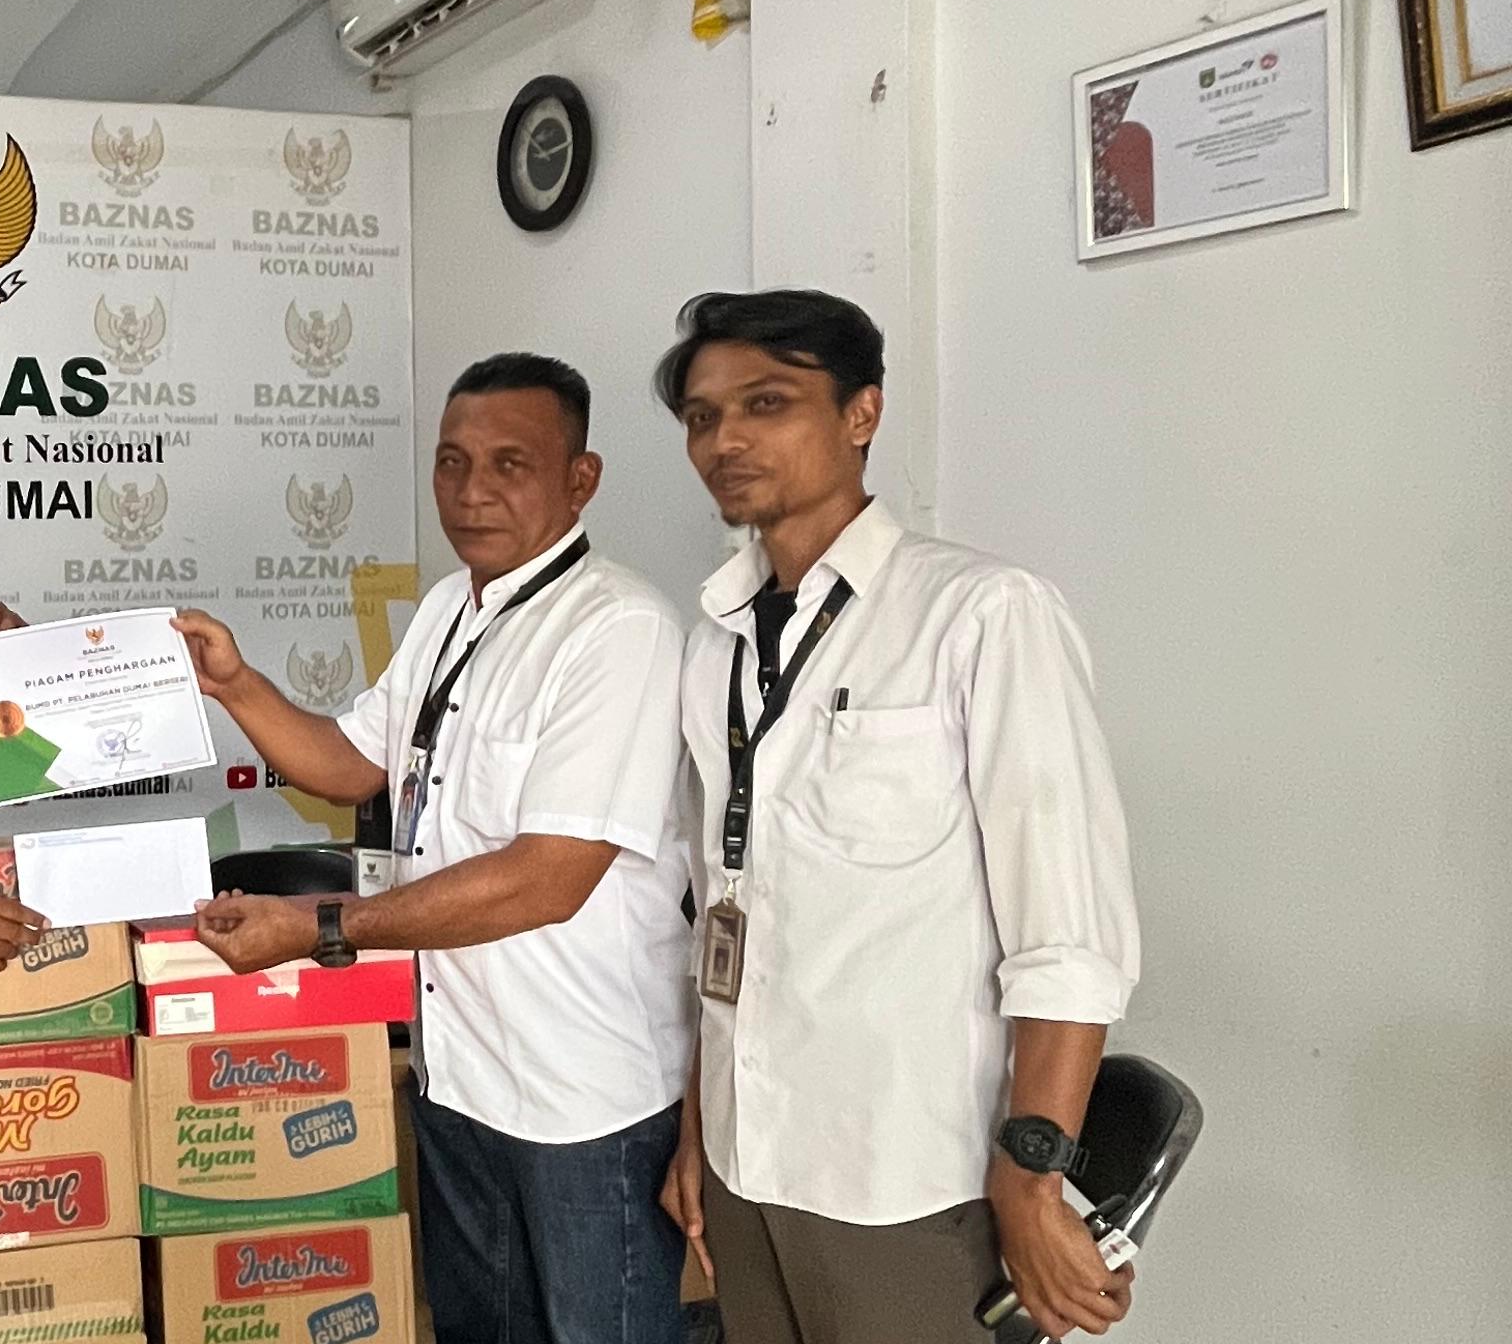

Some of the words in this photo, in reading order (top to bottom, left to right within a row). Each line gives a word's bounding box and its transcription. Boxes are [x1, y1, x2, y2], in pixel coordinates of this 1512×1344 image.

[59, 202, 194, 231] BAZNAS
[252, 210, 379, 238] BAZNAS
[67, 252, 120, 269] KOTA
[126, 254, 189, 271] DUMAI
[259, 258, 311, 276] KOTA
[315, 260, 374, 278] DUMAI
[254, 384, 380, 408] BAZNAS
[25, 433, 164, 464] Nasional
[261, 431, 311, 448] KOTA
[316, 431, 375, 448] DUMAI
[64, 558, 198, 584] BAZNAS
[255, 555, 381, 580] BAZNAS
[262, 603, 312, 620] KOTA
[25, 672, 74, 689] PIAGAM
[79, 656, 176, 679] PENGHARGAAN
[24, 934, 85, 967] GURIH
[14, 1074, 51, 1089] FRIED
[175, 1105, 241, 1121] Rasa
[298, 1112, 338, 1134] LEBIH
[177, 1121, 255, 1145] Kaldu
[291, 1119, 354, 1154] GURIH
[177, 1146, 256, 1172] Ayam
[202, 1303, 265, 1321] Rasa
